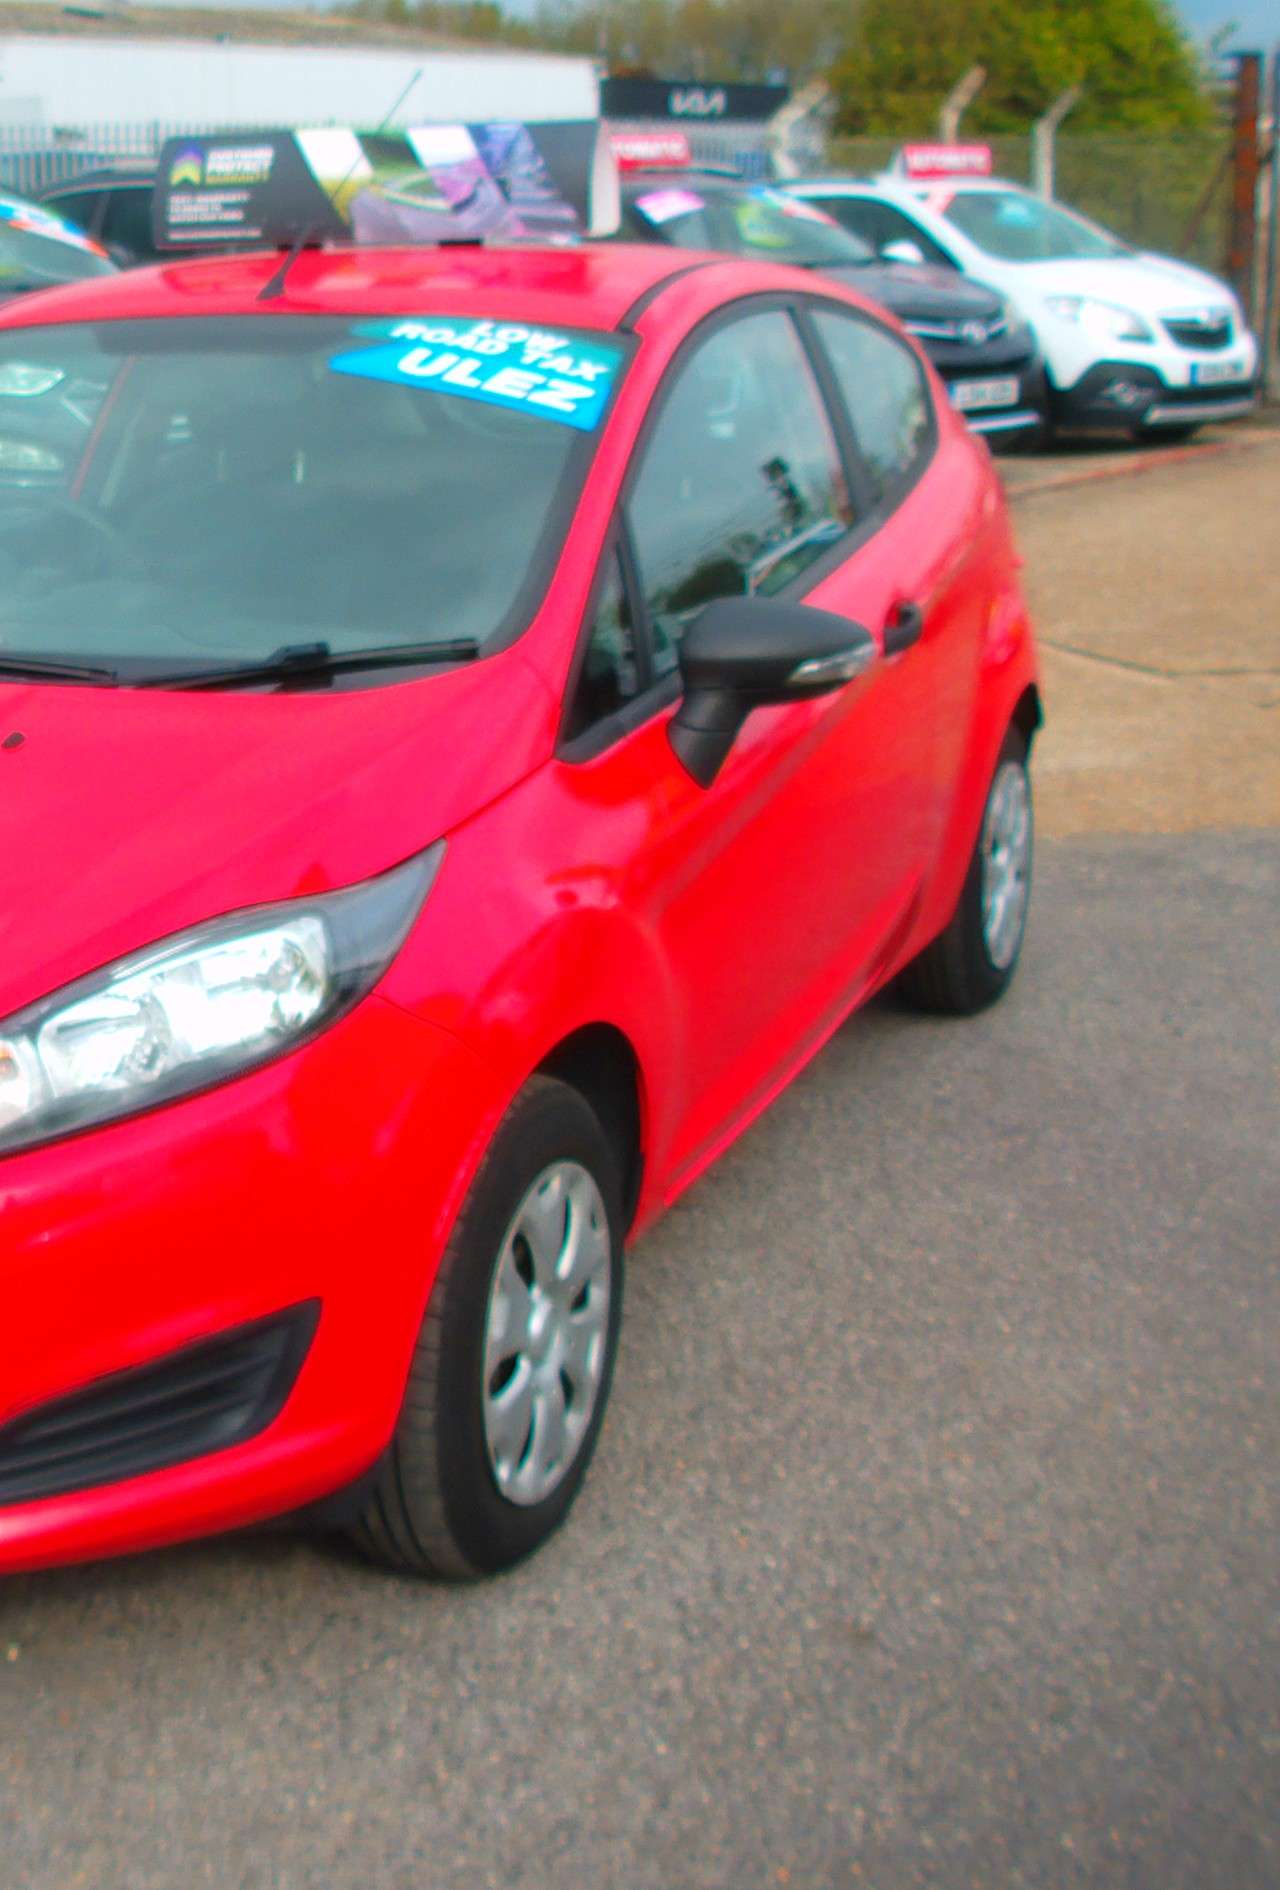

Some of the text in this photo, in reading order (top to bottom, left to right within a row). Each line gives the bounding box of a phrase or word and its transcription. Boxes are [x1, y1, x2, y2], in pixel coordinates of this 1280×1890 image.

[390, 322, 610, 382] ROAD TAX
[470, 319, 570, 352] LOW
[397, 346, 597, 412] ULEZ
